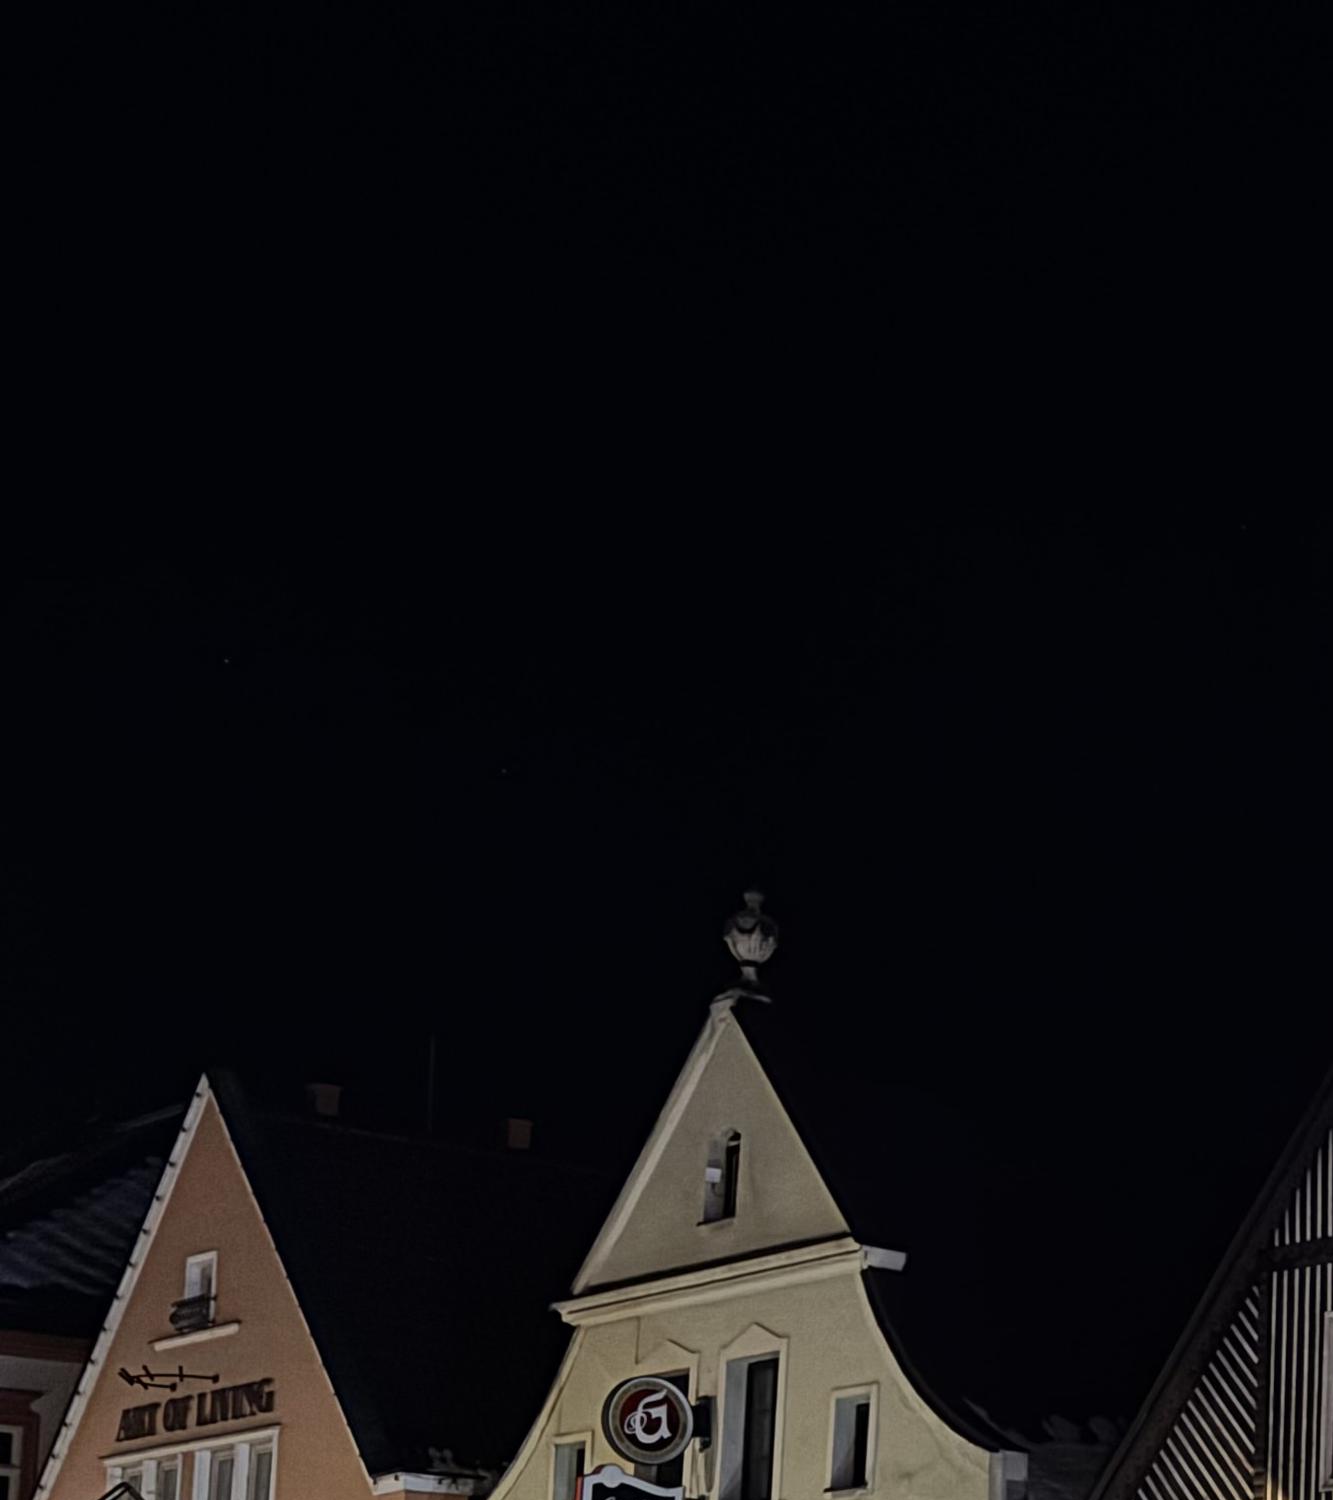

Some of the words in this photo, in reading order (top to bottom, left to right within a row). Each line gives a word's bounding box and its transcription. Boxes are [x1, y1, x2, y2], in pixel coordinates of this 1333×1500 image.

[116, 1402, 161, 1441] ART
[163, 1395, 195, 1432] OF
[196, 1378, 275, 1426] LIVING
